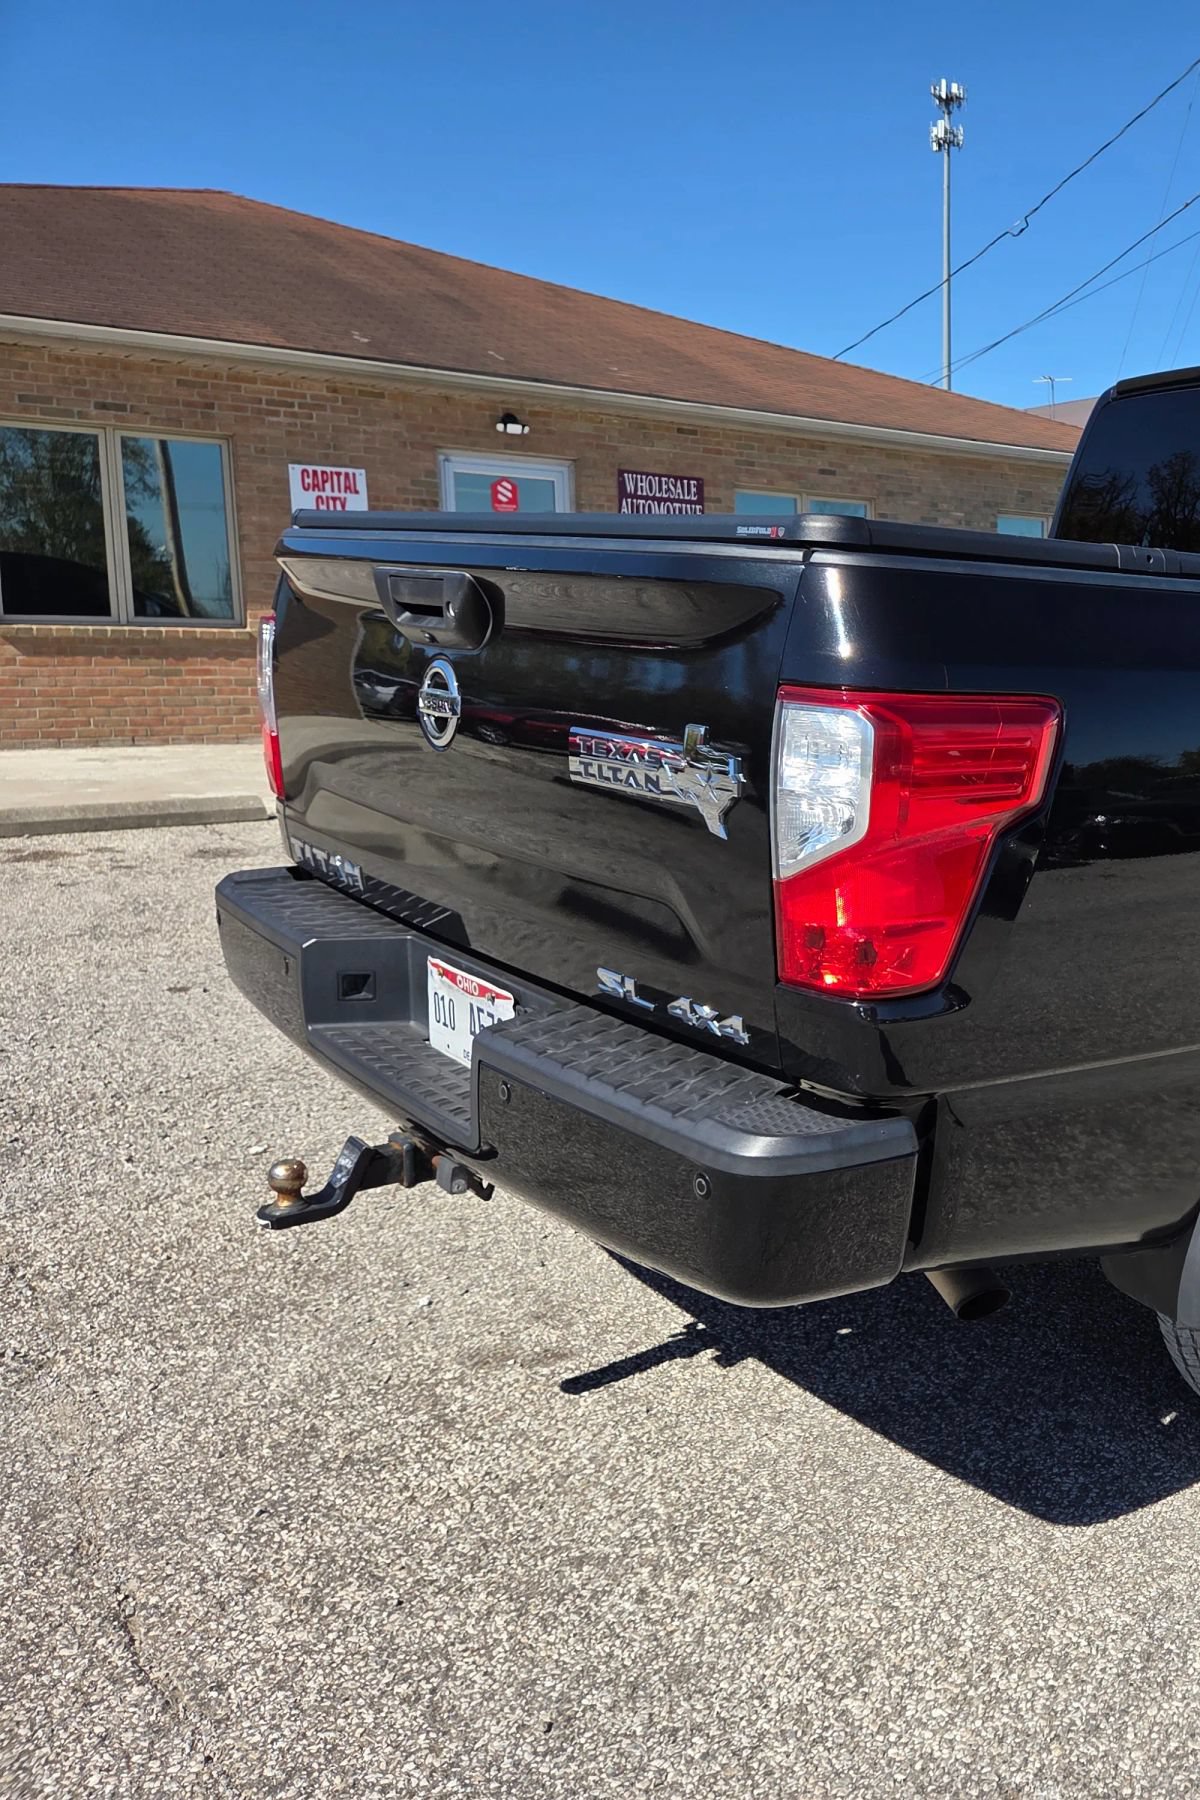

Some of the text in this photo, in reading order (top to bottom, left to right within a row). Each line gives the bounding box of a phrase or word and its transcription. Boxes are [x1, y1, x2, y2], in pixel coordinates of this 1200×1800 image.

[300, 468, 360, 495] CAPITAL
[623, 473, 698, 501] WHOLESALE
[620, 498, 703, 515] AUTOMOTIVE
[576, 735, 662, 769] TEXAS
[578, 759, 662, 795] TITAN
[456, 974, 480, 997] OHIO
[596, 966, 657, 1013] SL
[433, 991, 456, 1031] 010
